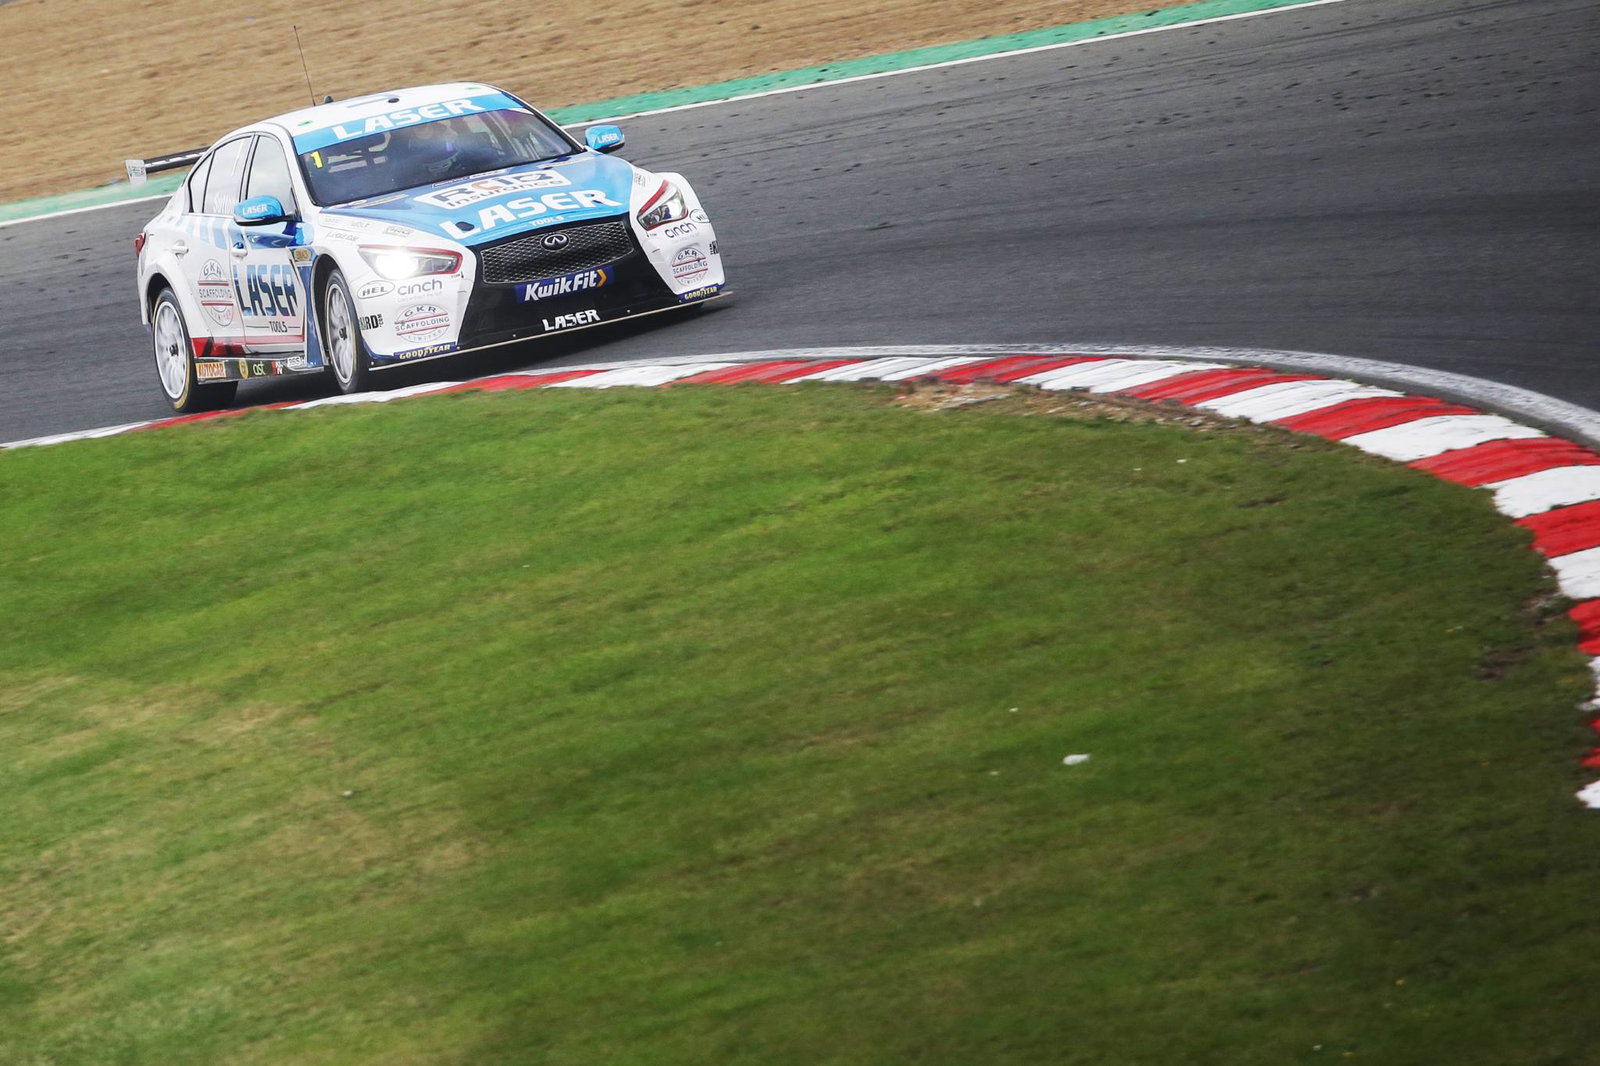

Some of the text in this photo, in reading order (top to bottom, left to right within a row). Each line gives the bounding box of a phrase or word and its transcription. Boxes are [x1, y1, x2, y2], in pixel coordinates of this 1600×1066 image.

[332, 99, 485, 139] LASER
[310, 151, 323, 168] 1
[242, 204, 269, 215] LASER
[440, 190, 623, 239] LASER
[529, 215, 566, 227] TOOLS
[664, 222, 697, 238] cinch
[672, 261, 708, 275] SCAFFOLDING
[233, 264, 298, 316] LASER
[362, 286, 387, 296] HEL
[397, 279, 442, 295] cinch
[684, 286, 718, 300] GOODYEAR
[404, 305, 436, 317] GKR
[269, 321, 288, 332] TOOLS
[395, 316, 449, 332] SCAFFOLDING
[542, 309, 600, 331] LASER
[399, 344, 451, 360] GOODYEAR
[198, 362, 225, 378] AUTOCAR
